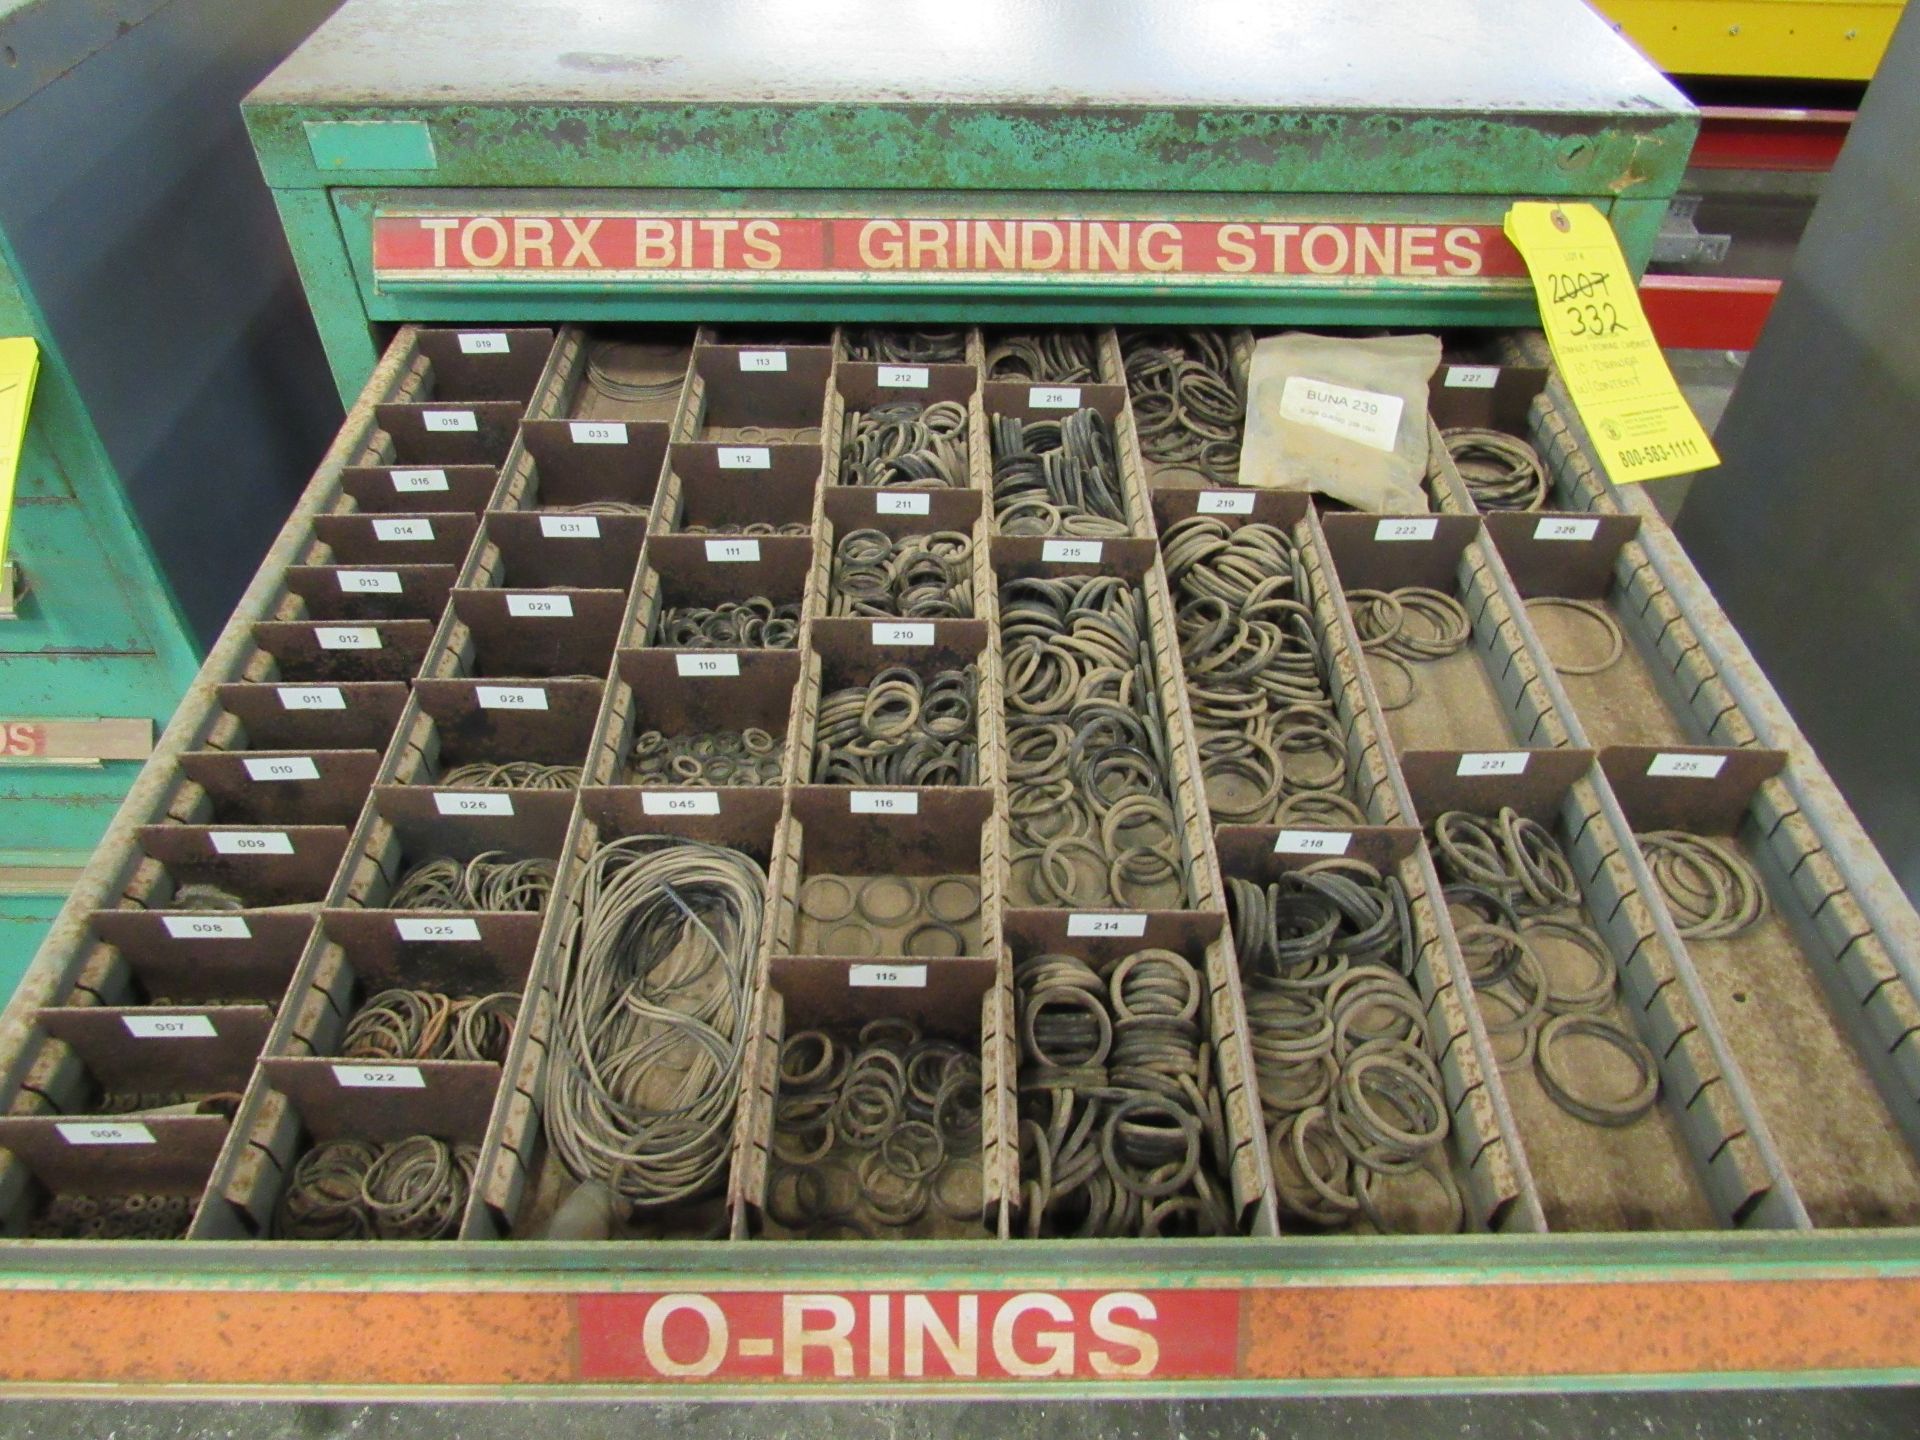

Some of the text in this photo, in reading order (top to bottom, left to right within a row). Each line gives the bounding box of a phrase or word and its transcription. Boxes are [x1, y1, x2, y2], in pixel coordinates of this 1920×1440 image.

[420, 216, 782, 269] TORX BITS
[857, 218, 1483, 276] GRINDING STONES
[1566, 302, 1629, 336] 332
[475, 340, 492, 349] 019
[755, 358, 771, 366] 113
[894, 373, 912, 382] 212
[1461, 373, 1482, 383] 227
[1045, 394, 1063, 403] 216
[1306, 389, 1379, 416] BUNA 239
[441, 418, 460, 426] 018
[588, 429, 609, 439] 033
[1617, 438, 1699, 468] 800-583-1111
[735, 455, 752, 464] 112
[410, 477, 431, 486] 016
[895, 500, 912, 509] 211
[1215, 499, 1235, 508] 219
[393, 526, 413, 535] 014
[559, 523, 581, 532] 031
[1394, 526, 1417, 535] 222
[725, 547, 740, 556] 111
[1061, 547, 1081, 557] 215
[358, 578, 380, 587] 013
[528, 602, 552, 611] 029
[338, 634, 360, 644] 012
[893, 630, 914, 640] 210
[698, 661, 717, 670] 110
[302, 695, 323, 704] 011
[499, 694, 525, 703] 028
[1481, 759, 1506, 770] 221
[269, 765, 294, 775] 010
[459, 800, 488, 810] 026
[668, 799, 696, 809] 045
[874, 799, 894, 808] 116
[237, 839, 266, 848] 009
[1299, 839, 1324, 849] 218
[192, 923, 223, 933] 008
[423, 926, 454, 935] 025
[1093, 921, 1119, 931] 214
[875, 972, 898, 982] 115
[363, 1072, 395, 1082] 022
[642, 1291, 1159, 1377] O-RINGS
